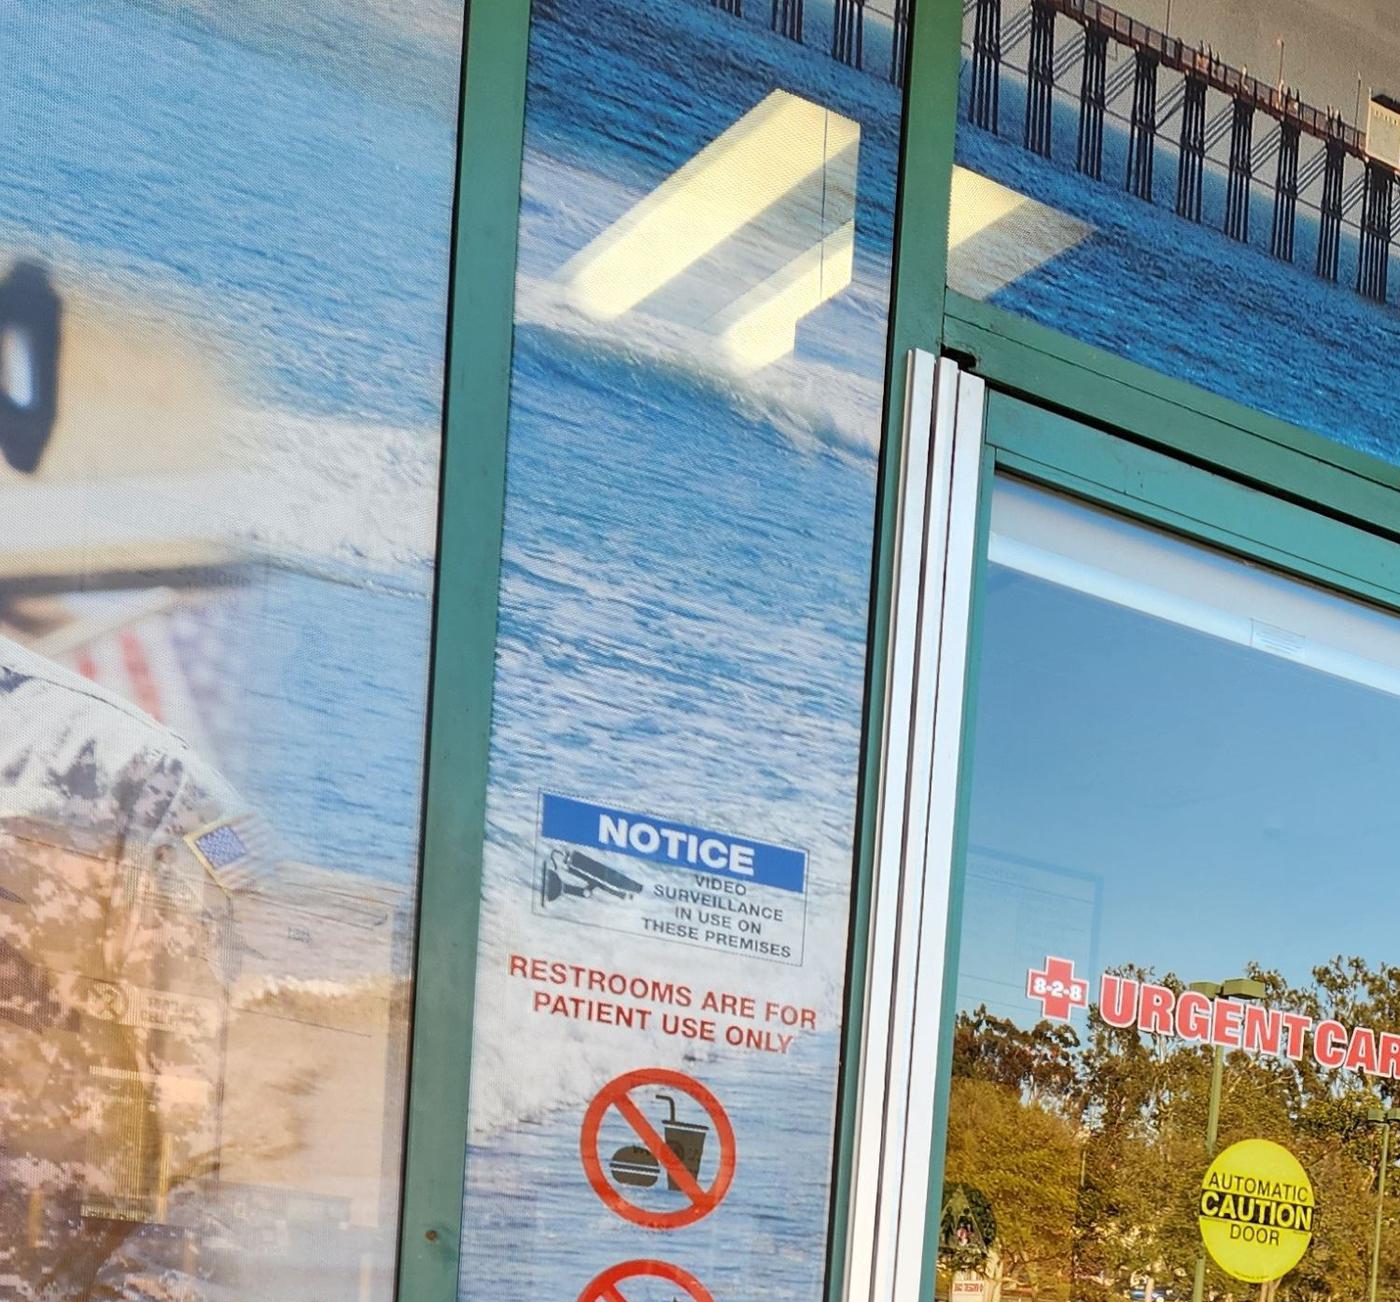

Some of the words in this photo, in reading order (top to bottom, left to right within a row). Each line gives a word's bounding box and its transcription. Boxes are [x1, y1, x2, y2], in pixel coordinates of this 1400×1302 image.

[599, 814, 755, 876] NOTICE
[653, 884, 783, 922] SURVEILLANCE
[694, 874, 747, 896] VIDEO
[641, 917, 699, 940] THESE
[705, 930, 791, 958] PREMISES
[675, 906, 692, 920] IN
[698, 910, 732, 929] USE
[738, 919, 762, 935] ON
[508, 954, 693, 1007] RESTROOMS
[701, 991, 757, 1020] ARE
[765, 1002, 818, 1030] FOR
[533, 991, 651, 1031] PATIENT
[661, 1013, 717, 1042] USE
[725, 1025, 795, 1054] ONLY
[1033, 977, 1084, 1000] 8-2-8
[1100, 974, 1312, 1061] URGENT
[1208, 1172, 1308, 1202] AUTOMATIC
[1201, 1190, 1313, 1230] CAUTION
[1230, 1224, 1280, 1246] DOOR
